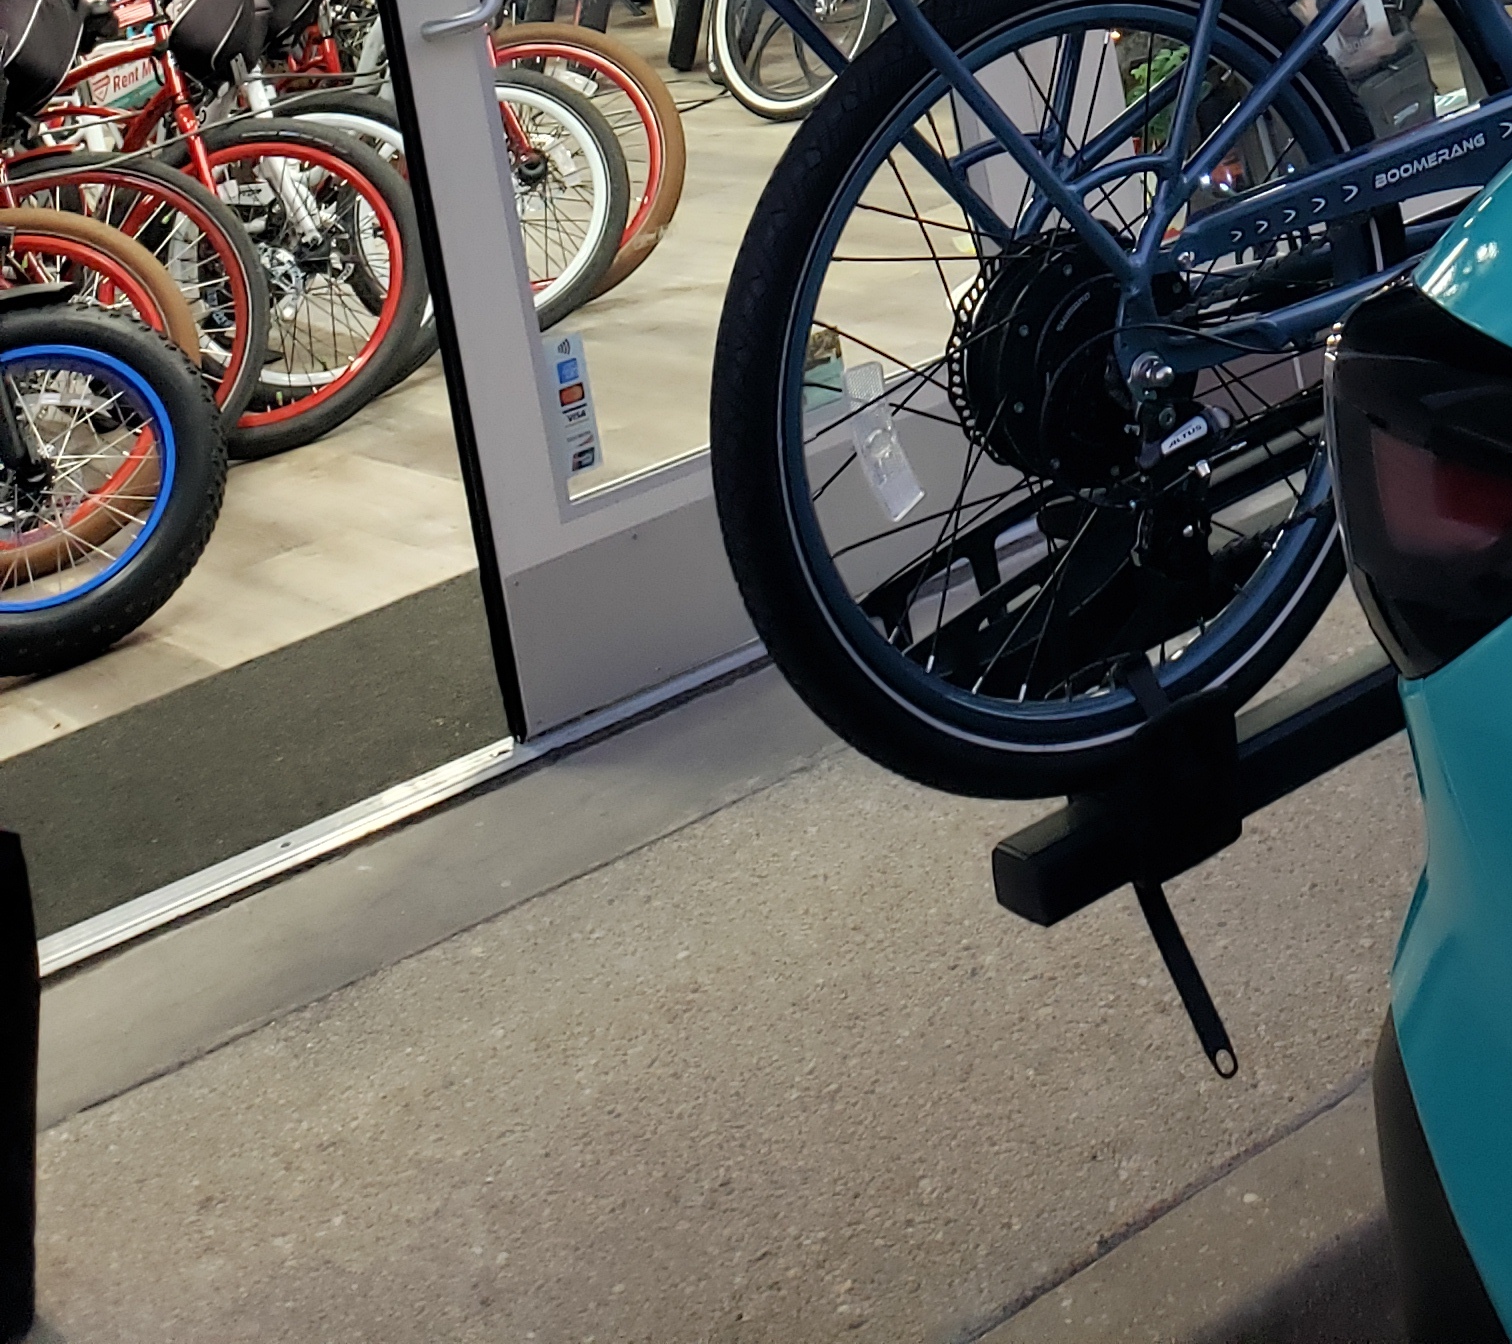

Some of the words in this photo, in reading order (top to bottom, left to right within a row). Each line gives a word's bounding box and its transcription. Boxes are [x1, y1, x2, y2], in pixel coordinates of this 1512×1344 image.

[113, 66, 139, 93] Rent
[1374, 132, 1486, 190] BOOMERANG
[1168, 424, 1202, 449] ALTUS
